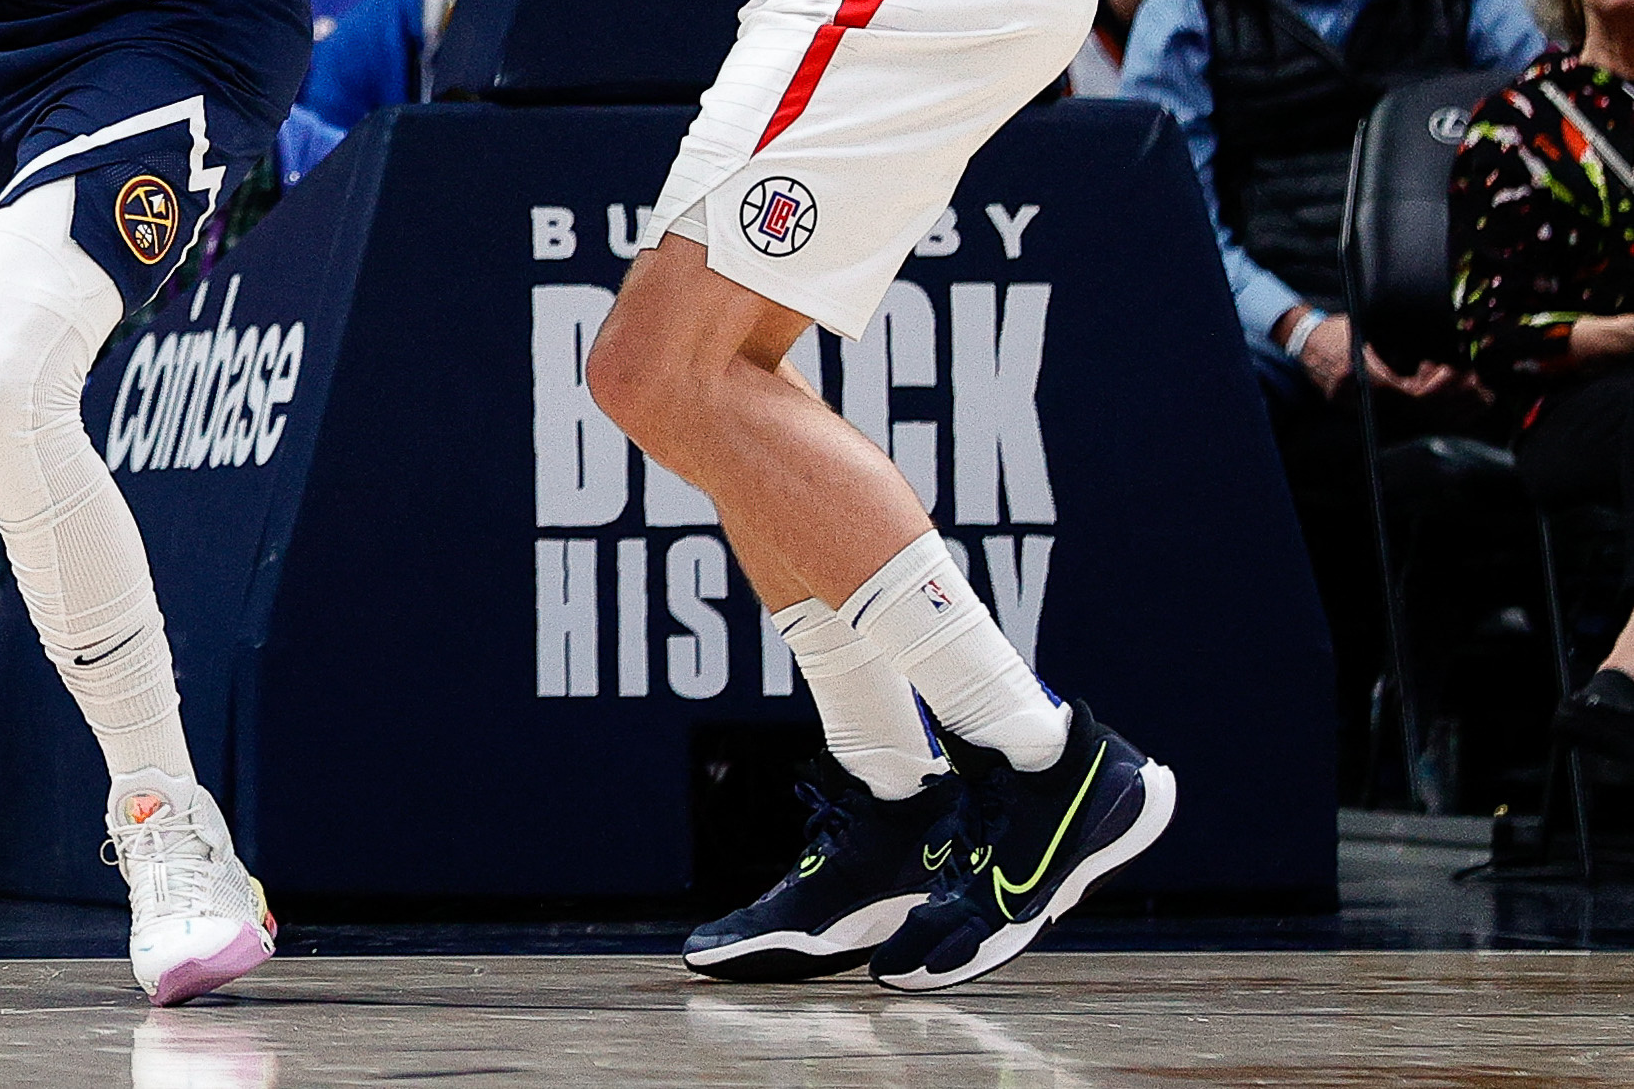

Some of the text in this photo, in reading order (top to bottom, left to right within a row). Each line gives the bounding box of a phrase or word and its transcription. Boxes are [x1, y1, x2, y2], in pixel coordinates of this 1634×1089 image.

[105, 273, 304, 473] coinbase
[532, 281, 1057, 528] BCK
[535, 535, 1055, 698] HISY
